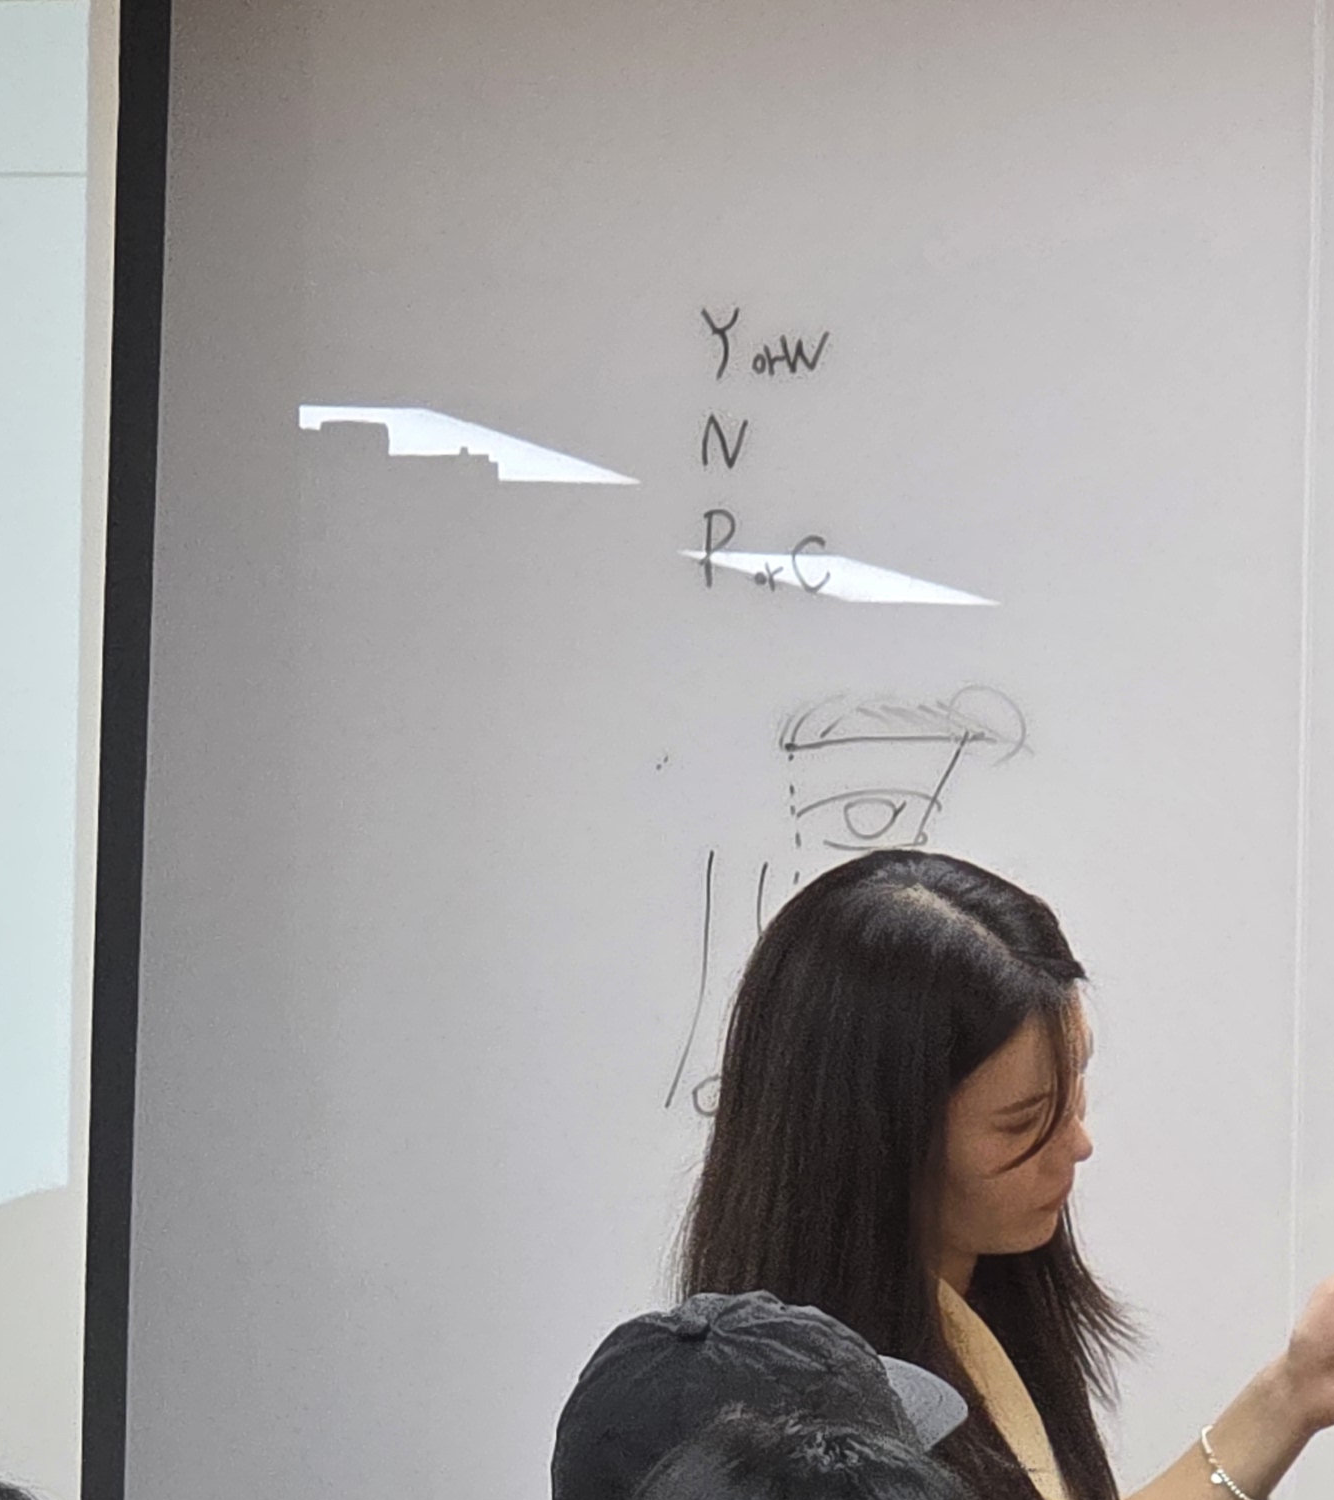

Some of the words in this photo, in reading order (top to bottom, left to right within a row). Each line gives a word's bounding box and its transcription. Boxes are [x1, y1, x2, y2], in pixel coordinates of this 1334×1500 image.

[700, 306, 741, 382] Y
[701, 413, 749, 470] N
[698, 508, 737, 590] P
[791, 534, 831, 594] C
